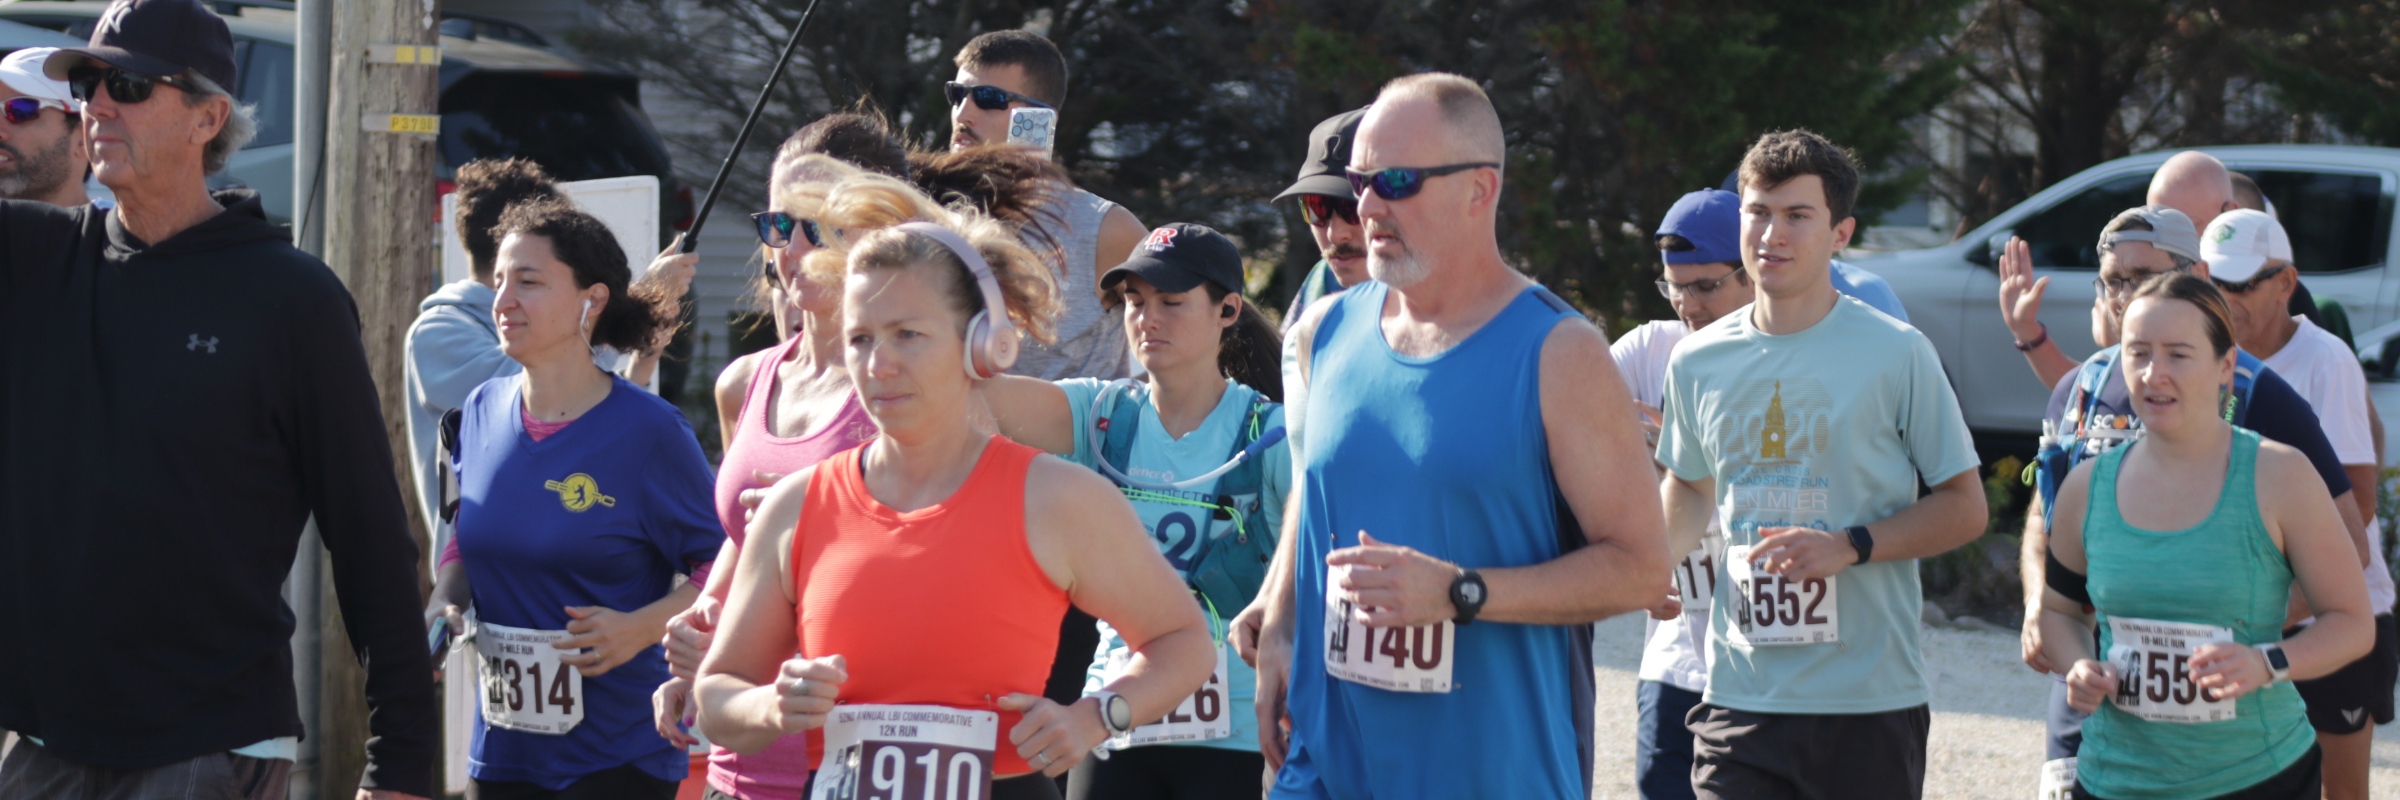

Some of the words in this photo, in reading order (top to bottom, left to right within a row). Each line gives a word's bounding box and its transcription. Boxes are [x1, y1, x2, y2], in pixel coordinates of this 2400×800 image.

[1144, 228, 1178, 246] R
[1801, 477, 1829, 488] RUN
[1768, 490, 1828, 510] MILER
[1753, 576, 1828, 627] 552
[1364, 605, 1443, 671] 140
[504, 658, 575, 715] 314
[857, 711, 886, 722] ANNUAL
[888, 711, 900, 722] LBI
[902, 712, 973, 728] COMMEMORATIVE
[879, 724, 897, 737] 12K
[899, 724, 919, 738] RUN
[871, 744, 982, 800] 910
